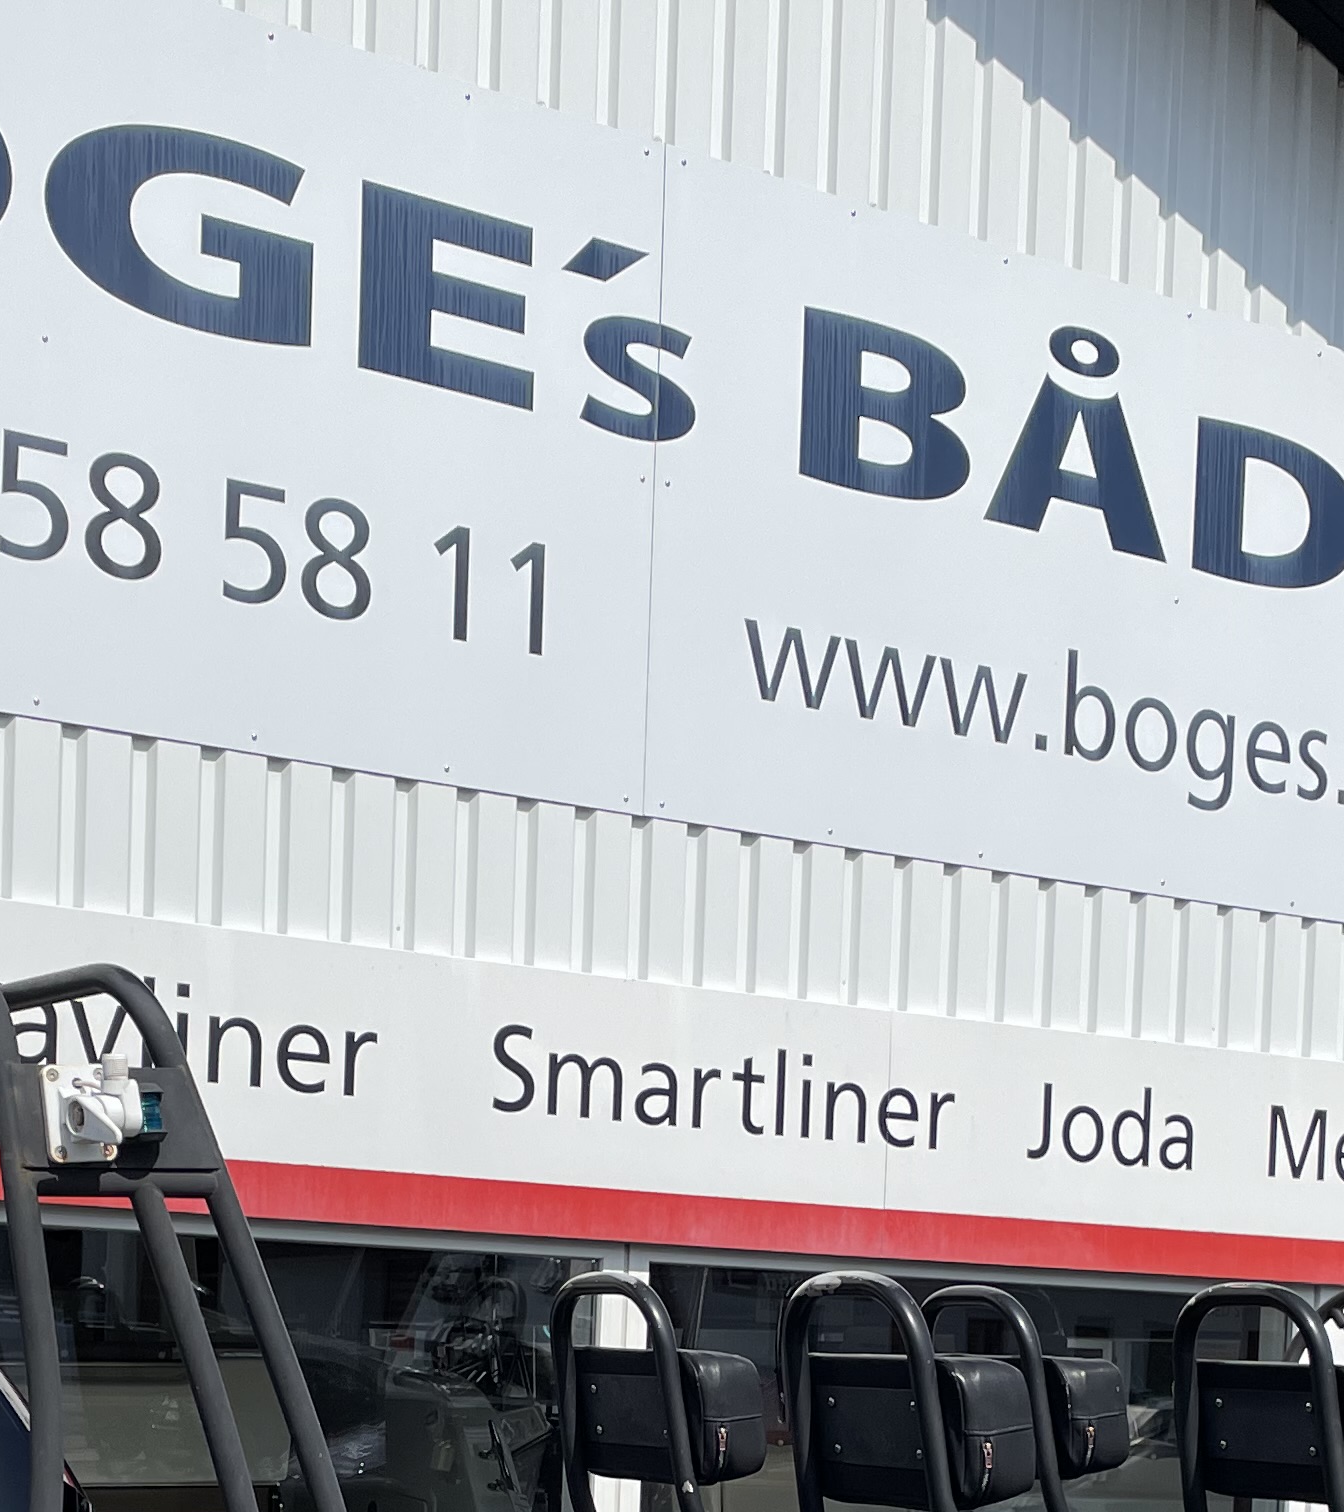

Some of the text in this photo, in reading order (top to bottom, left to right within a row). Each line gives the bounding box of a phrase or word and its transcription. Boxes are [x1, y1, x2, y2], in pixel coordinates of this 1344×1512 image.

[222, 477, 372, 620] 58
[433, 525, 546, 656] 11
[491, 1023, 955, 1151] Smartliner
[1026, 1082, 1194, 1172] Joda
